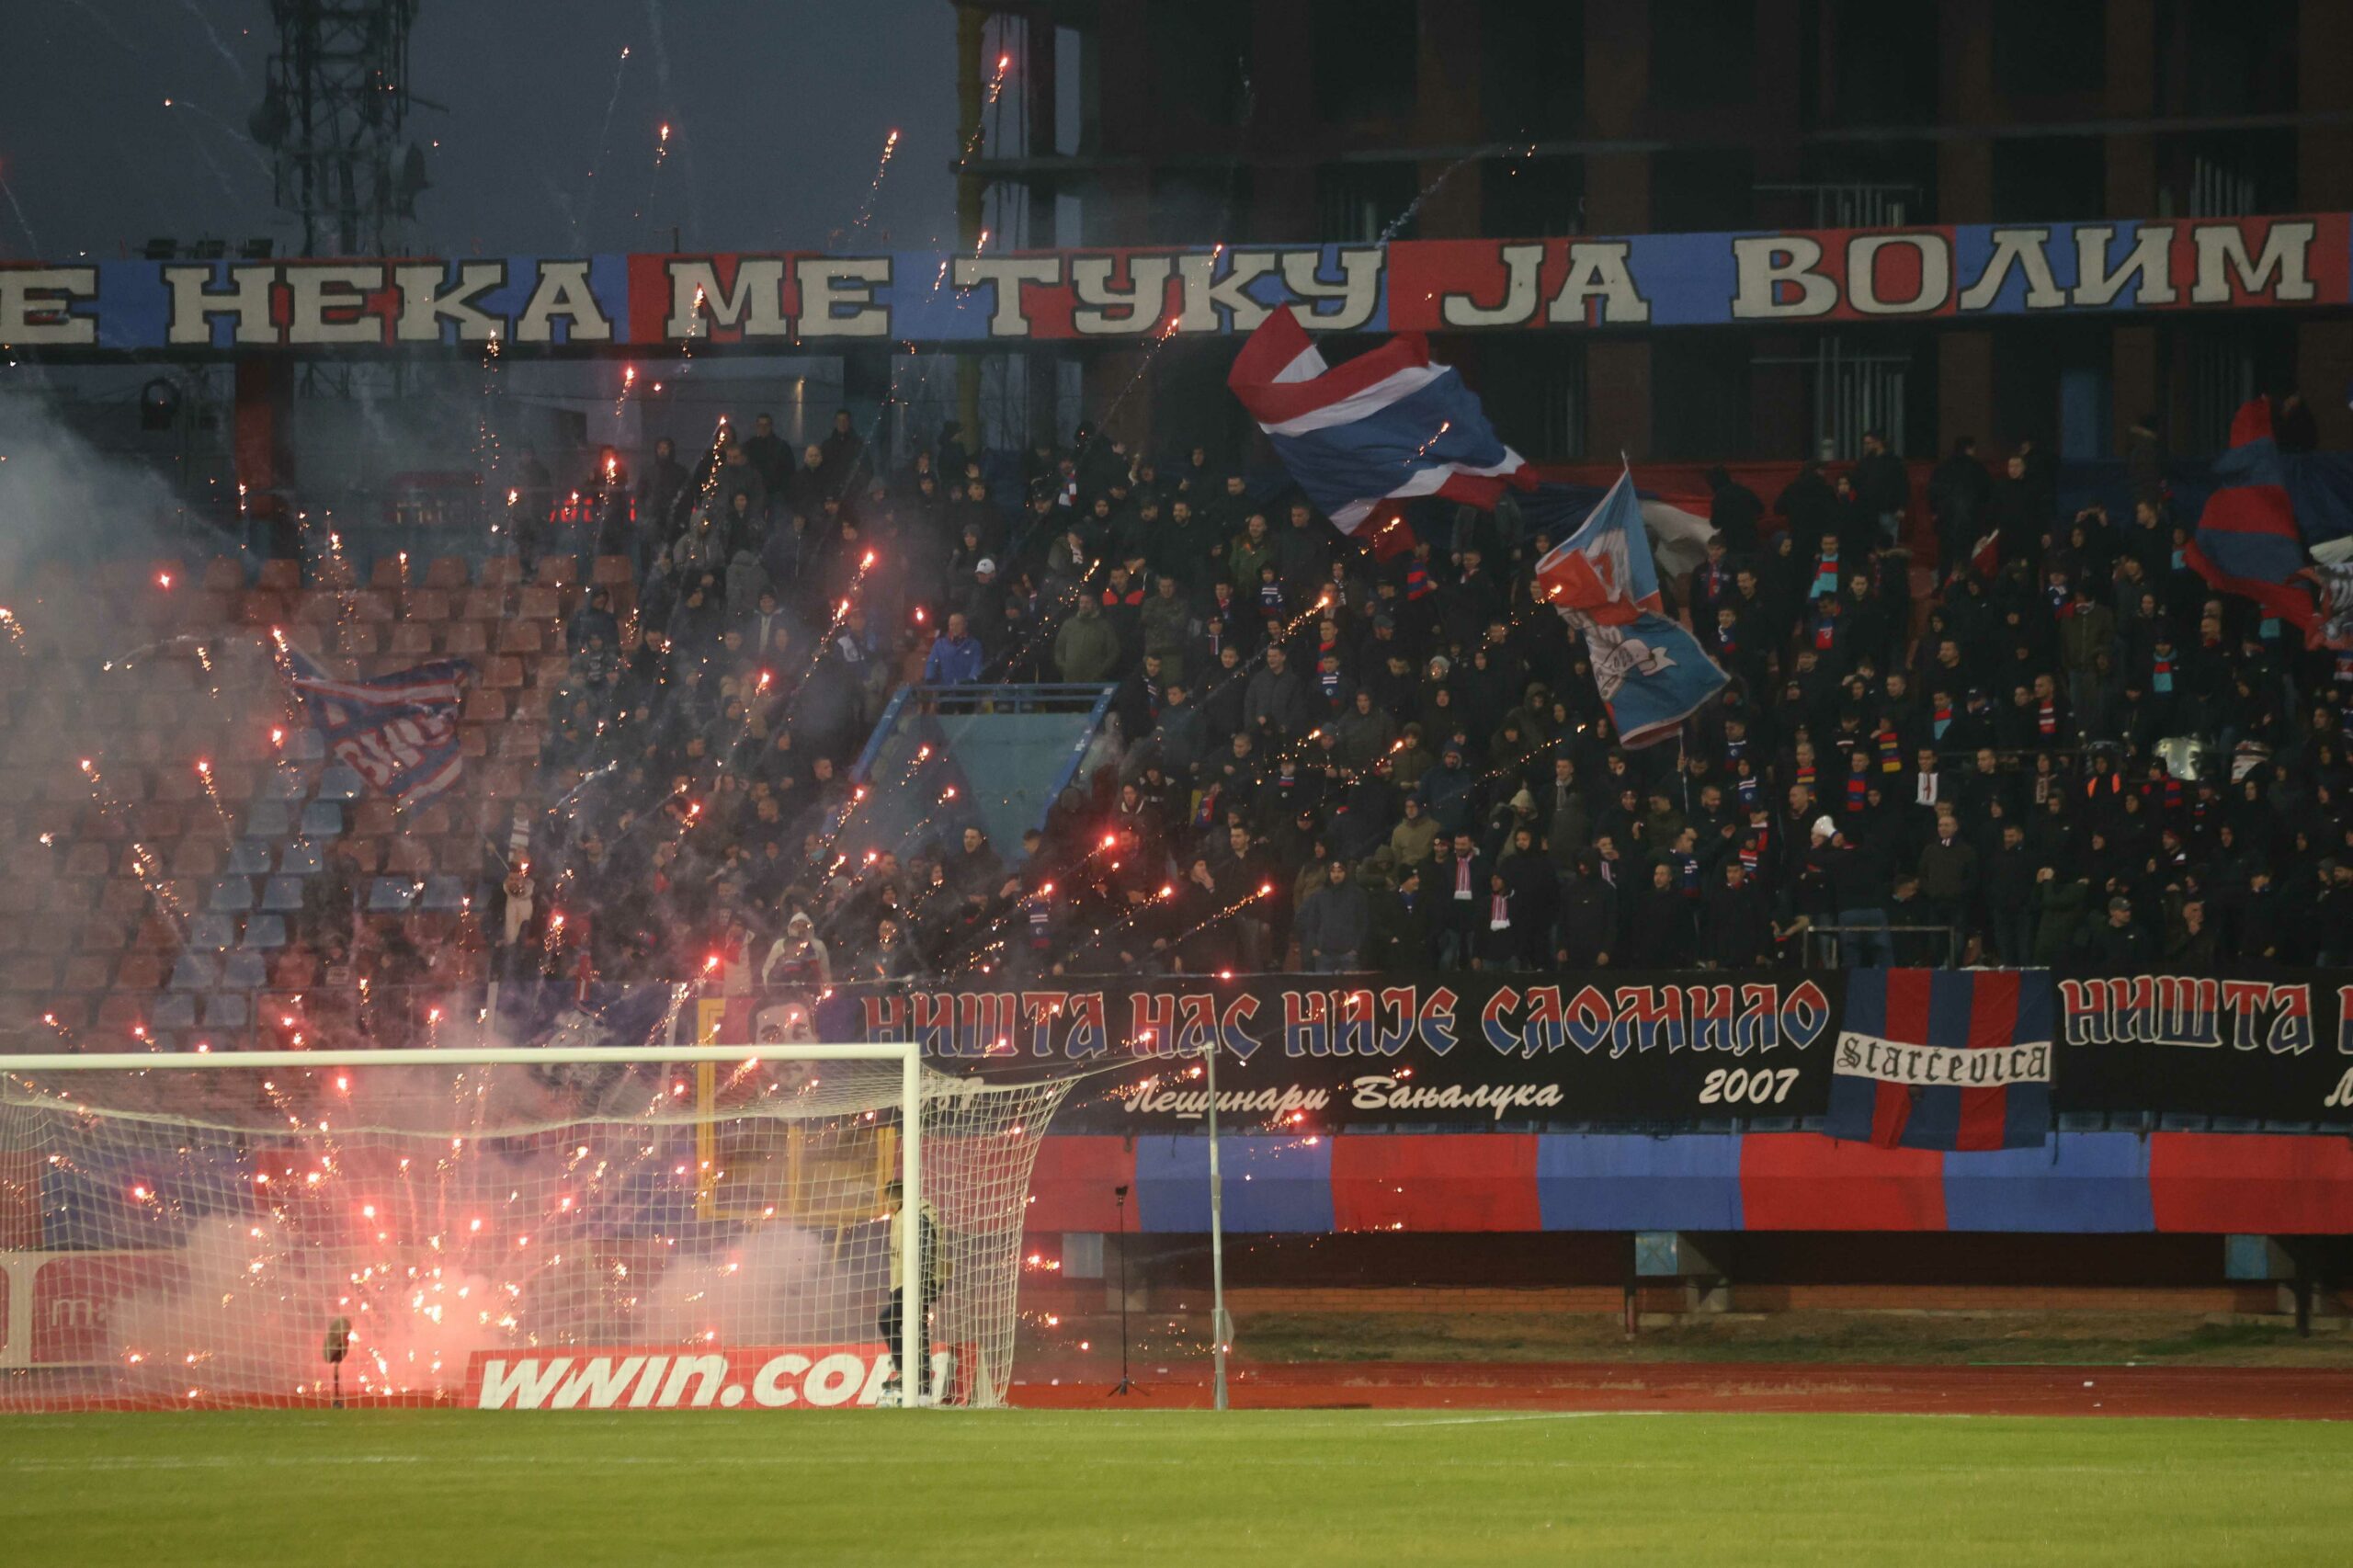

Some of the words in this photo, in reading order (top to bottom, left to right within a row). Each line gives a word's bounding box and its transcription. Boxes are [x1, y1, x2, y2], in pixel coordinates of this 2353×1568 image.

[164, 260, 611, 346] НЕКА
[667, 256, 892, 341] МЕ
[954, 247, 1382, 337] ТУКУ
[1443, 242, 1650, 326] ЈА
[1731, 222, 2316, 320] ВОЛИМ
[1698, 1067, 1800, 1104] 2007
